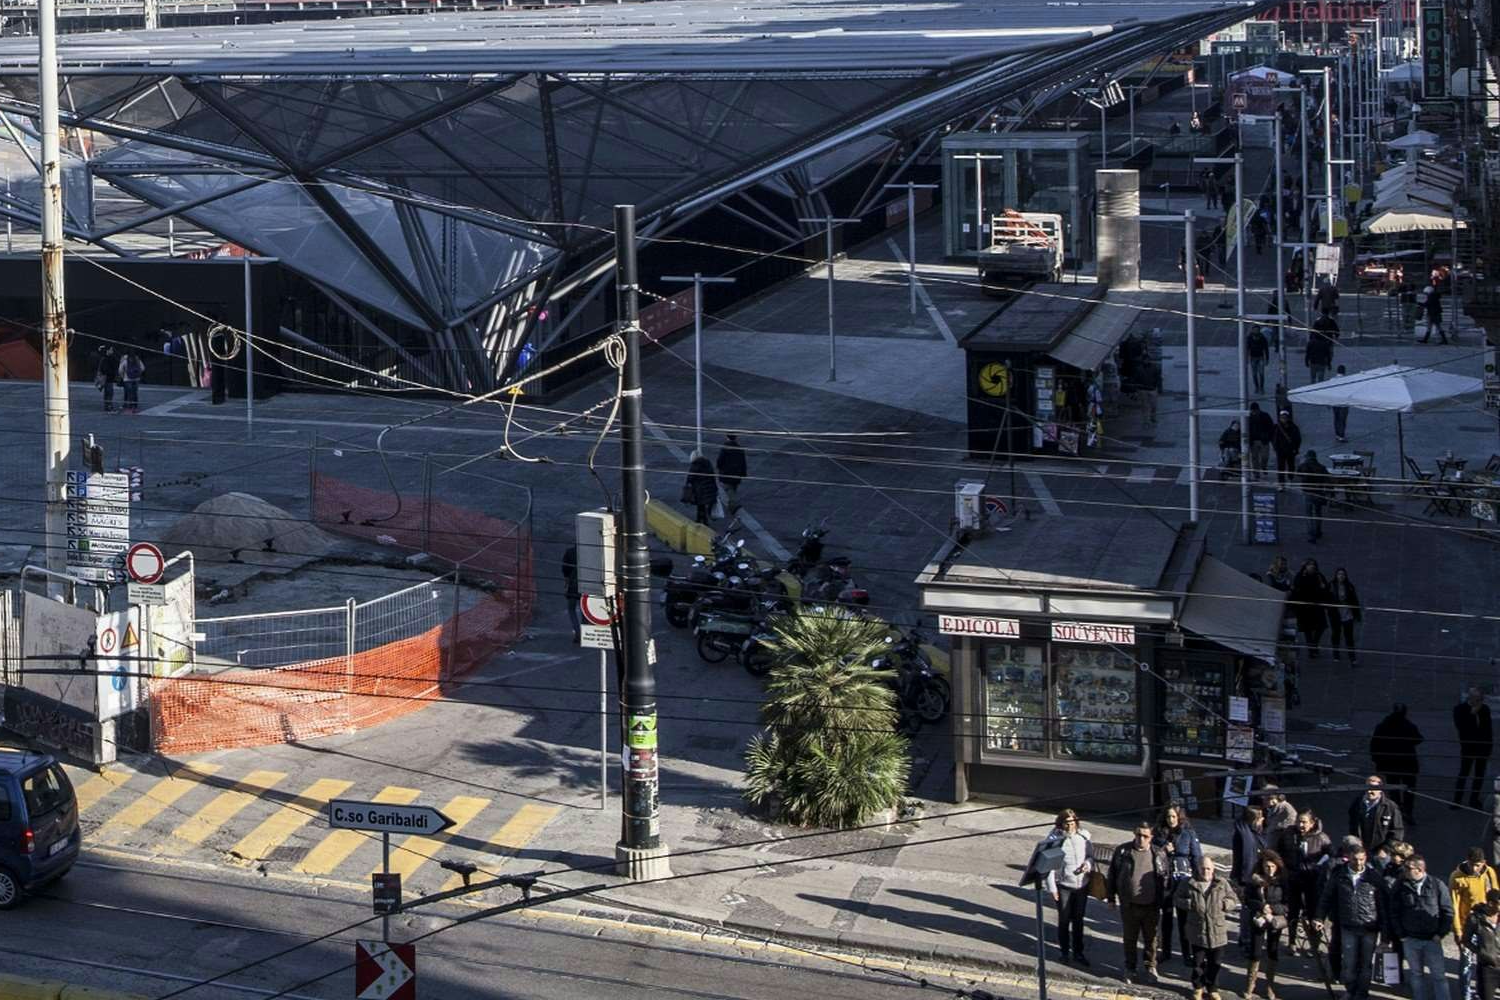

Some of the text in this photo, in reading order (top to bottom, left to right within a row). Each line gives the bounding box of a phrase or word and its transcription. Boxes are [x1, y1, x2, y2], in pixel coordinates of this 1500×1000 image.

[1427, 10, 1442, 95] HOTEL
[942, 617, 1132, 643] EDICOLA SOUVENIR
[334, 807, 428, 828] C.so Garibaldi
